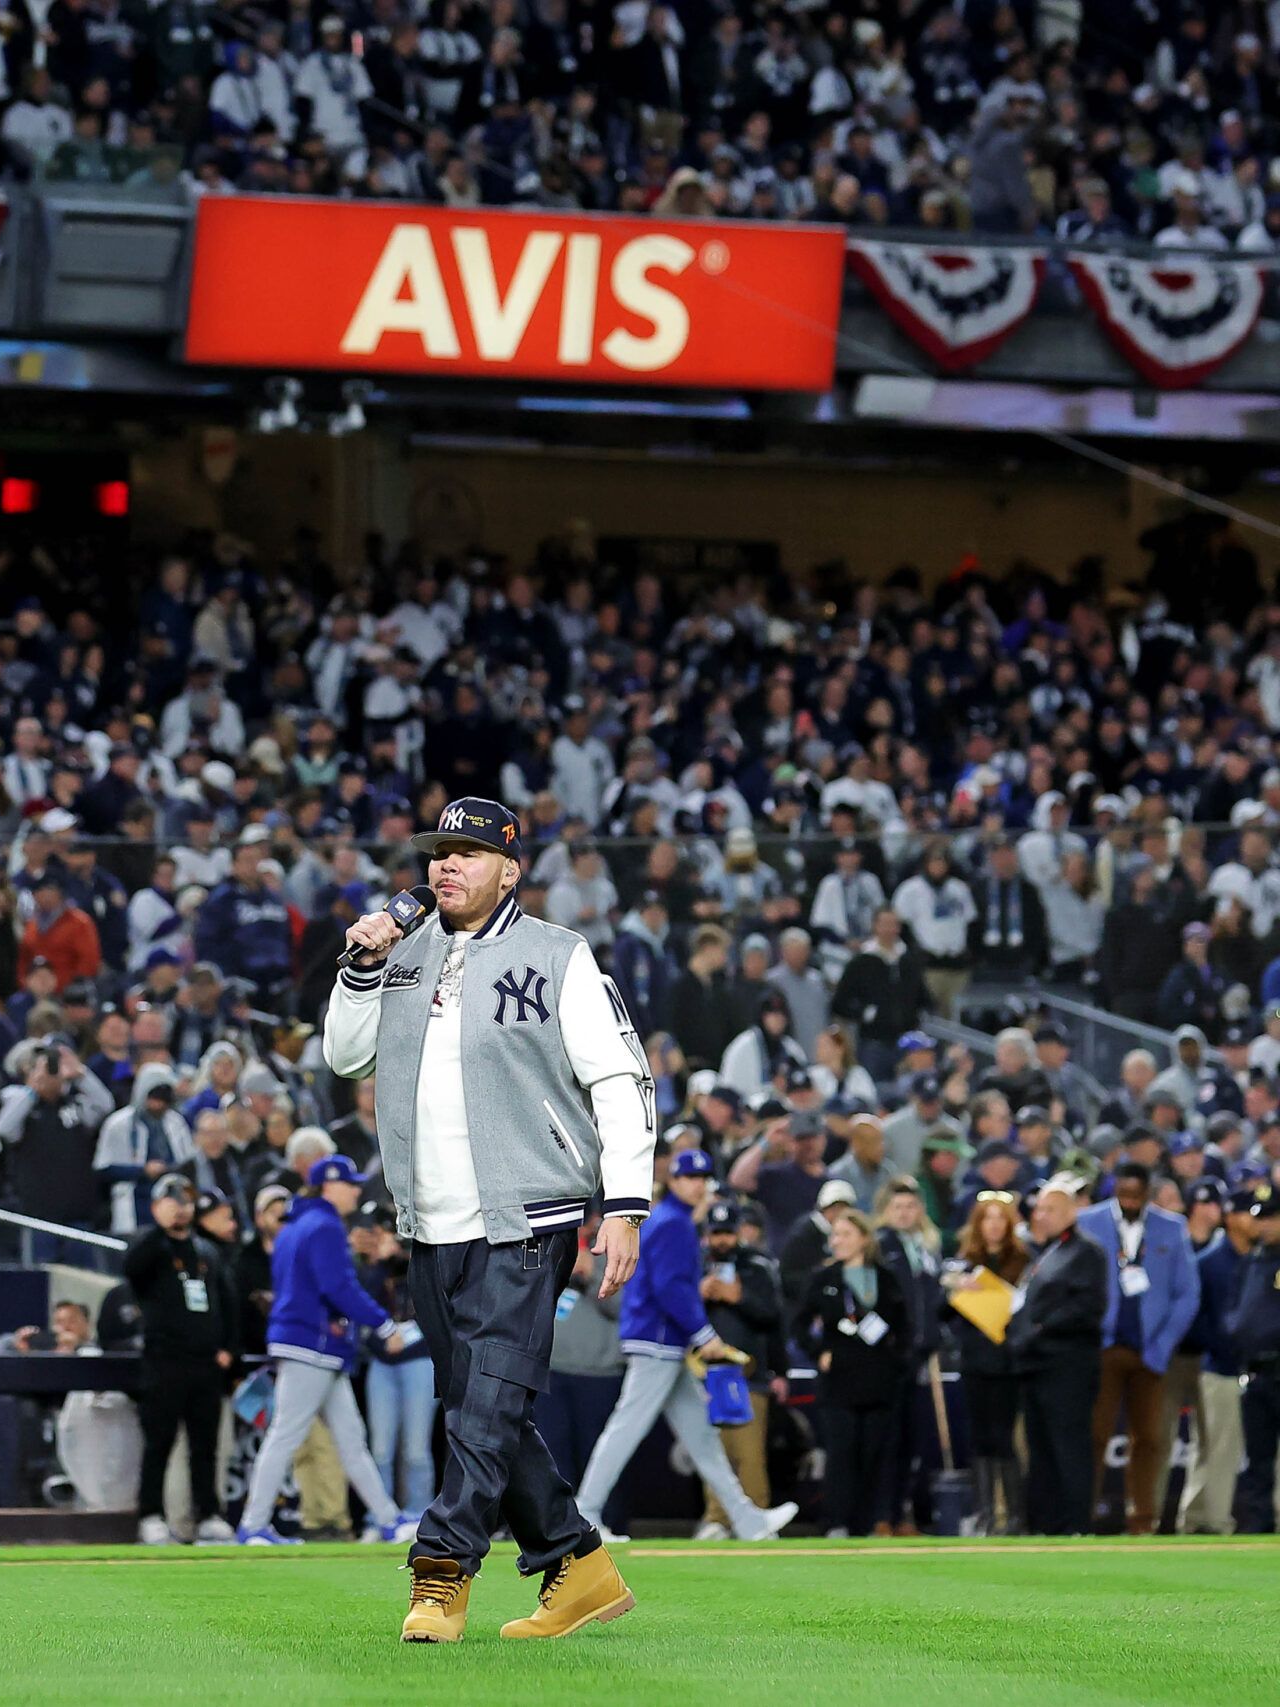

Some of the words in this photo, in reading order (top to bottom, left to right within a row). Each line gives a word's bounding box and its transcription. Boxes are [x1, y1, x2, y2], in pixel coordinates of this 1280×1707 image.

[444, 807, 467, 831] NY
[382, 963, 422, 987] York
[491, 964, 553, 1029] NY
